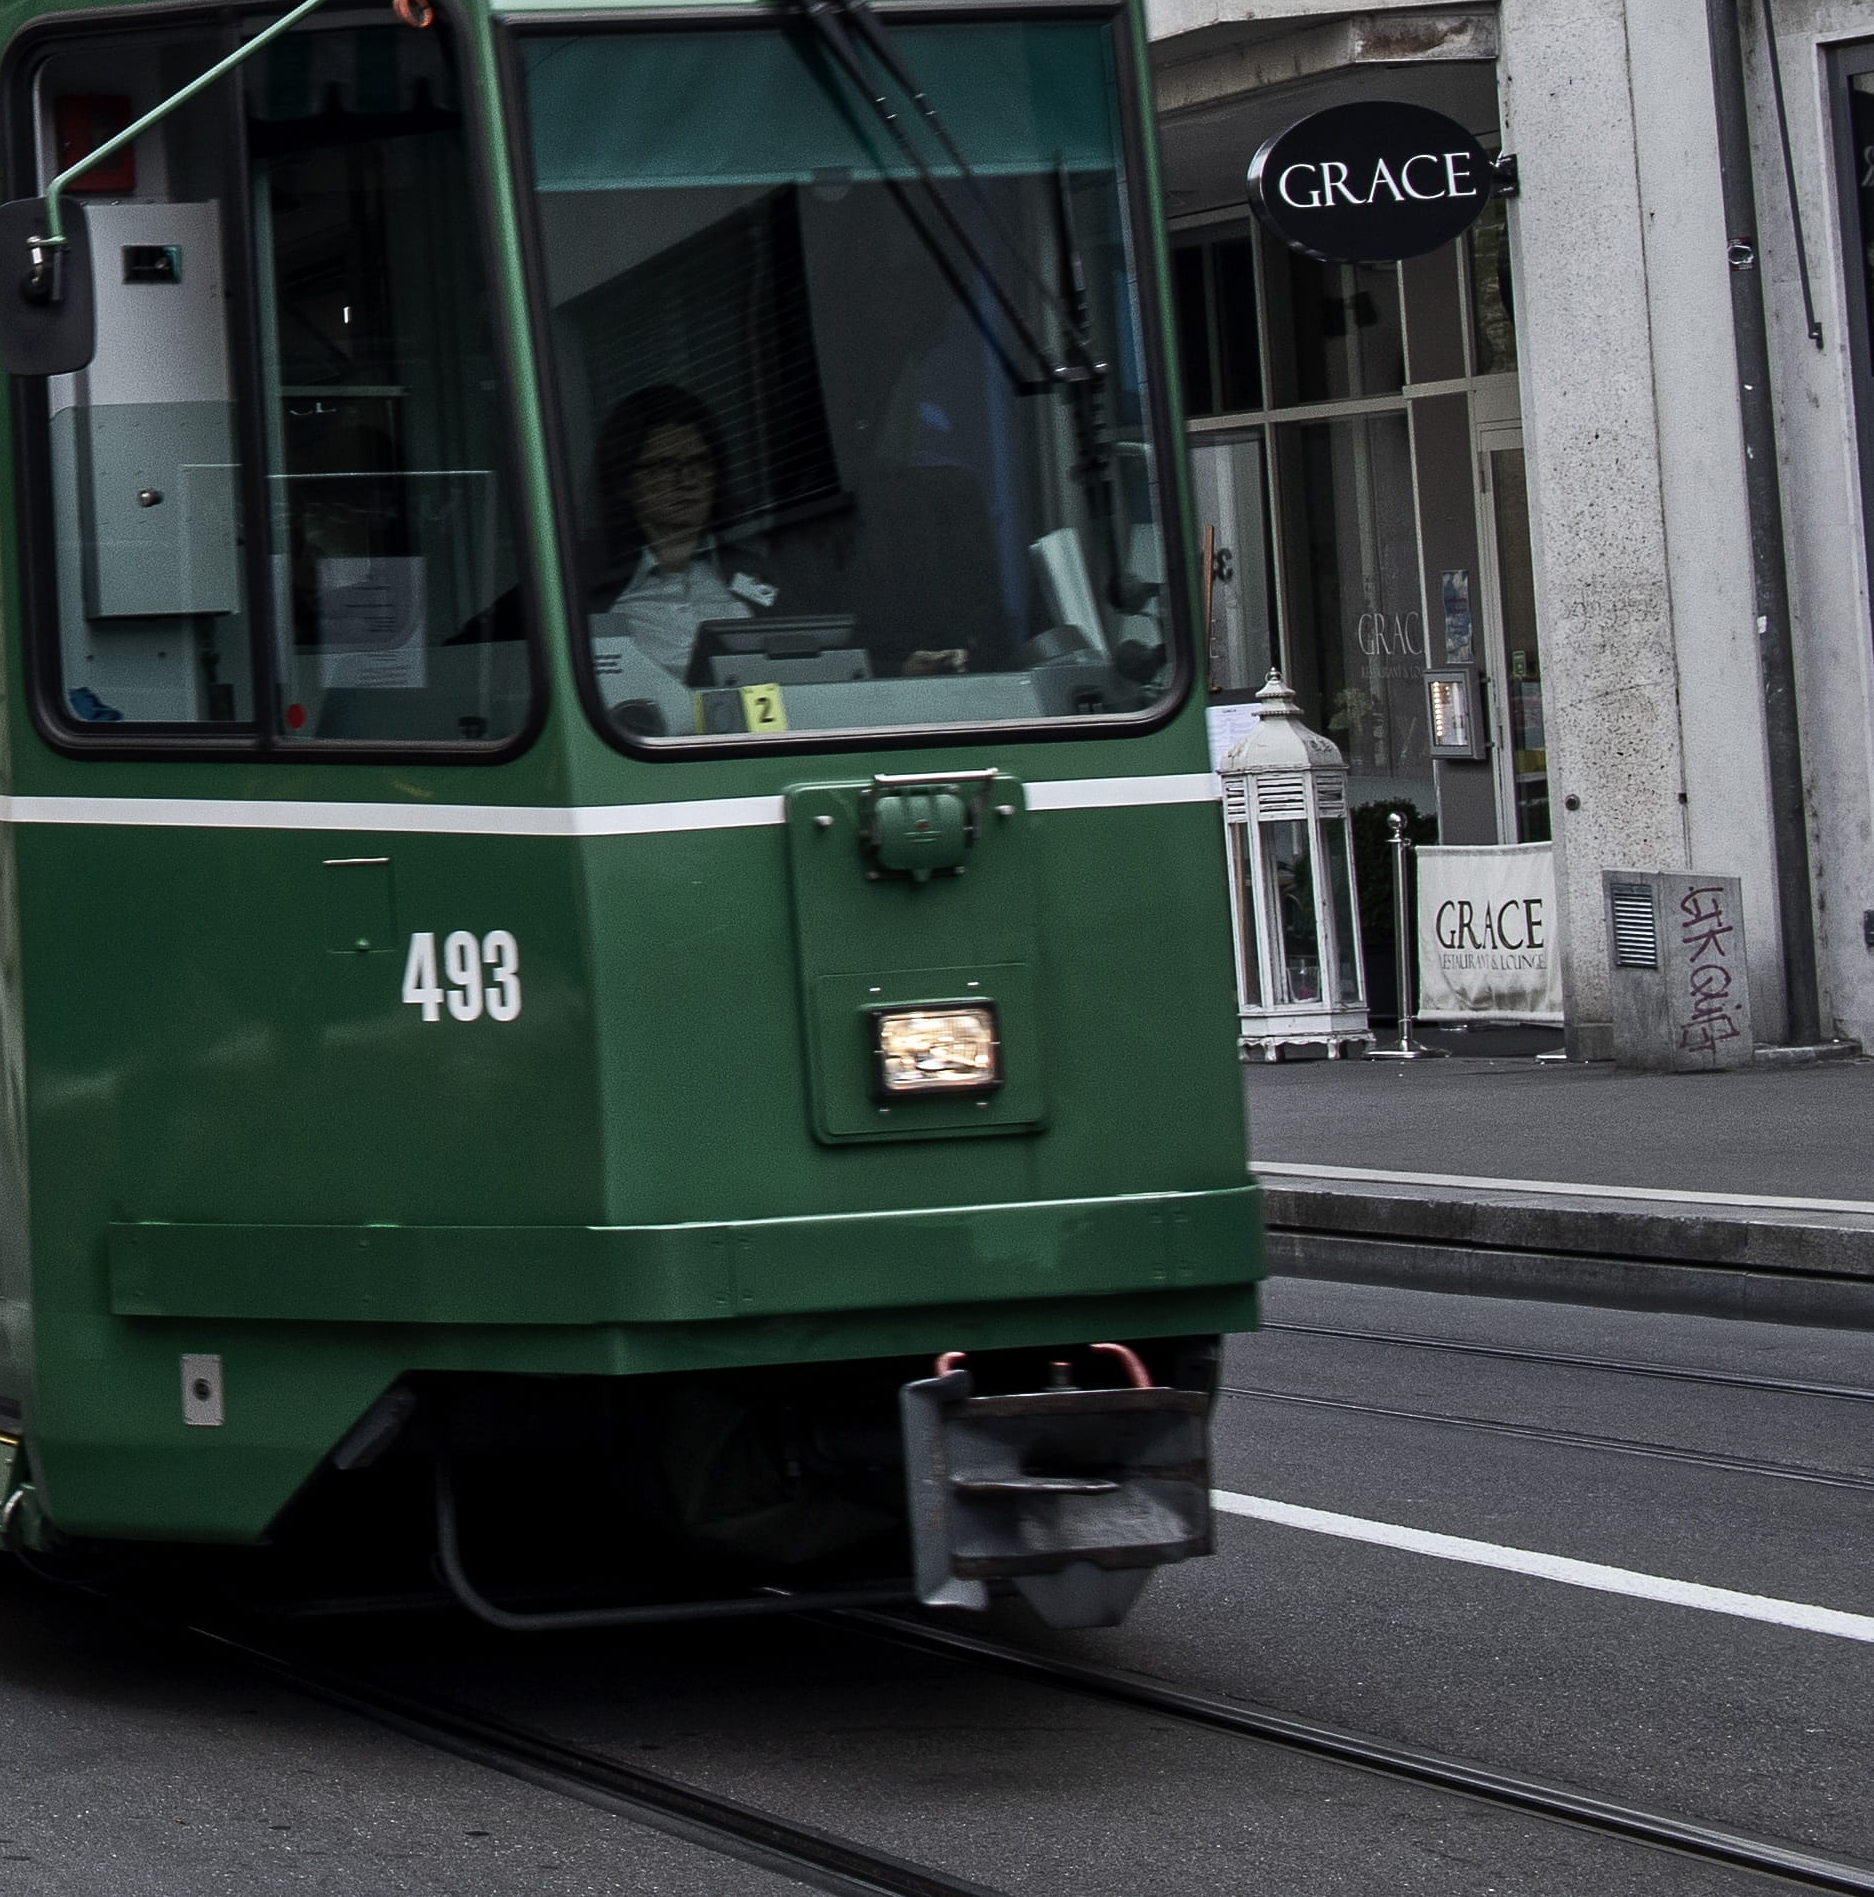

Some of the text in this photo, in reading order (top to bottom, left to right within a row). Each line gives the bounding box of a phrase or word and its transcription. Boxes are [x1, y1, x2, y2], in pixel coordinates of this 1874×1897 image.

[1278, 151, 1477, 209] GRACE
[1358, 611, 1423, 655] GRAC
[755, 697, 777, 723] 2
[1436, 899, 1544, 950] GRACE
[402, 930, 523, 1022] 493
[1491, 956, 1498, 970] &
[1500, 953, 1548, 970] LOUNGE
